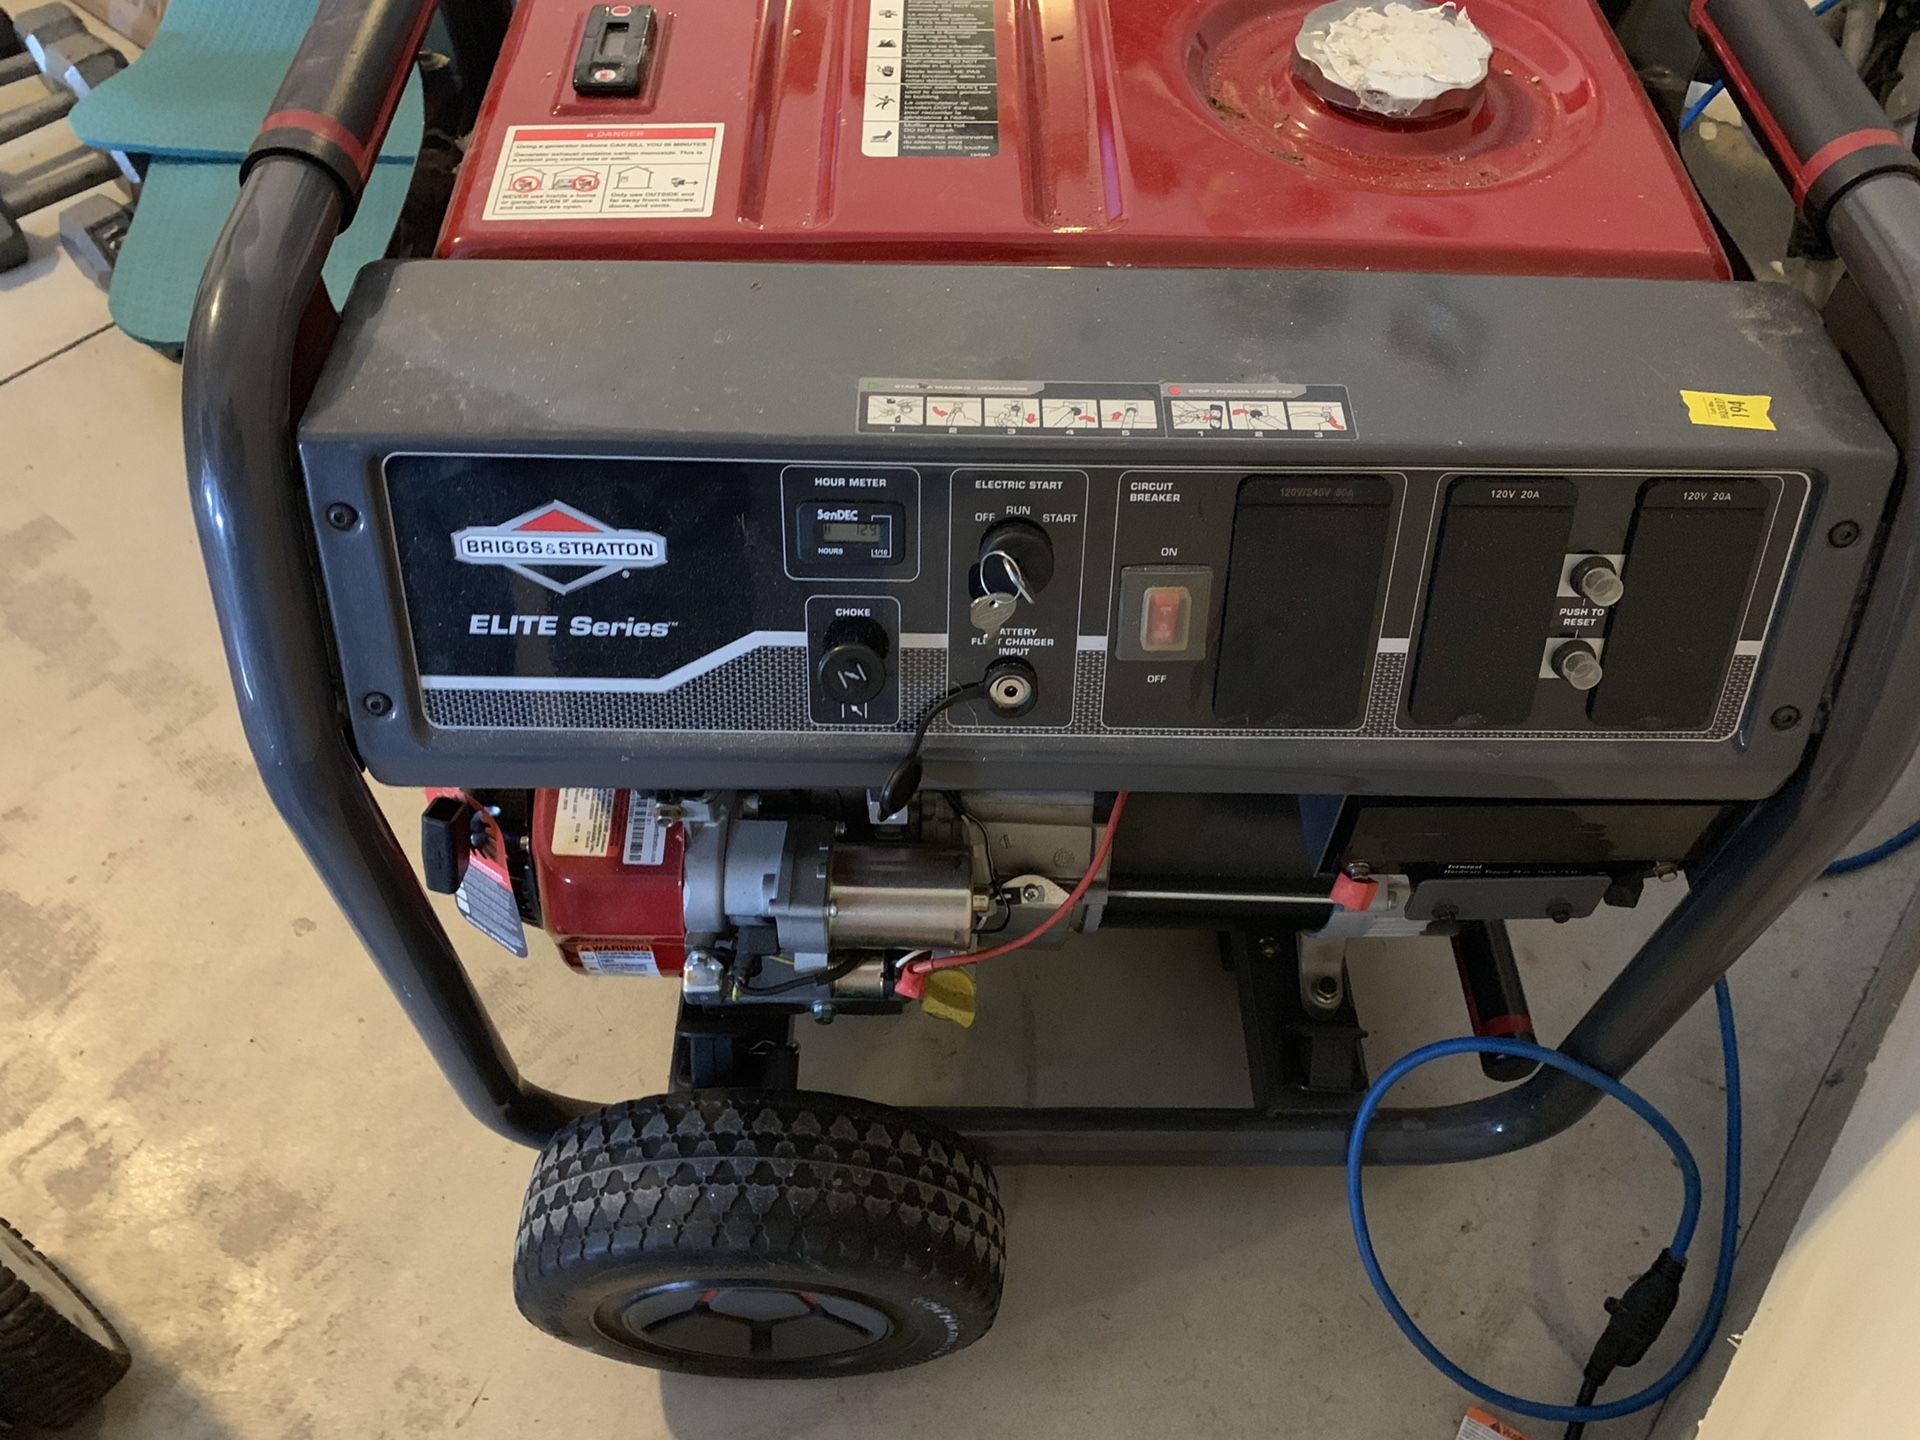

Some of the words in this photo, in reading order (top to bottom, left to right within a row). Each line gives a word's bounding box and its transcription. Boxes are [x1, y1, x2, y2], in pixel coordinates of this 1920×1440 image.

[814, 478, 846, 487] HOUR
[848, 478, 887, 488] METER
[975, 480, 1026, 490] ELECTRIC
[1029, 480, 1064, 490] START
[1130, 482, 1174, 492] CIRCUIT
[1130, 492, 1181, 502] BREAKER
[1490, 490, 1516, 499] 120V
[1520, 490, 1540, 499] 20A
[1682, 491, 1708, 501] 120V
[1712, 492, 1732, 501] 20A
[1006, 506, 1031, 515] RUN
[974, 512, 996, 522] OFF
[1042, 514, 1078, 523] START
[818, 548, 844, 556] HOURS
[1160, 547, 1178, 557] ON
[834, 608, 871, 618] CHOKE
[1559, 608, 1588, 616] PUSH
[1591, 608, 1605, 616] TO
[468, 614, 560, 636] ELITE
[1562, 618, 1597, 626] RESET
[997, 628, 1038, 636] ATTERY
[1005, 638, 1054, 647] CHARGER
[998, 648, 1030, 656] INPUT
[1147, 674, 1168, 684] OFF
